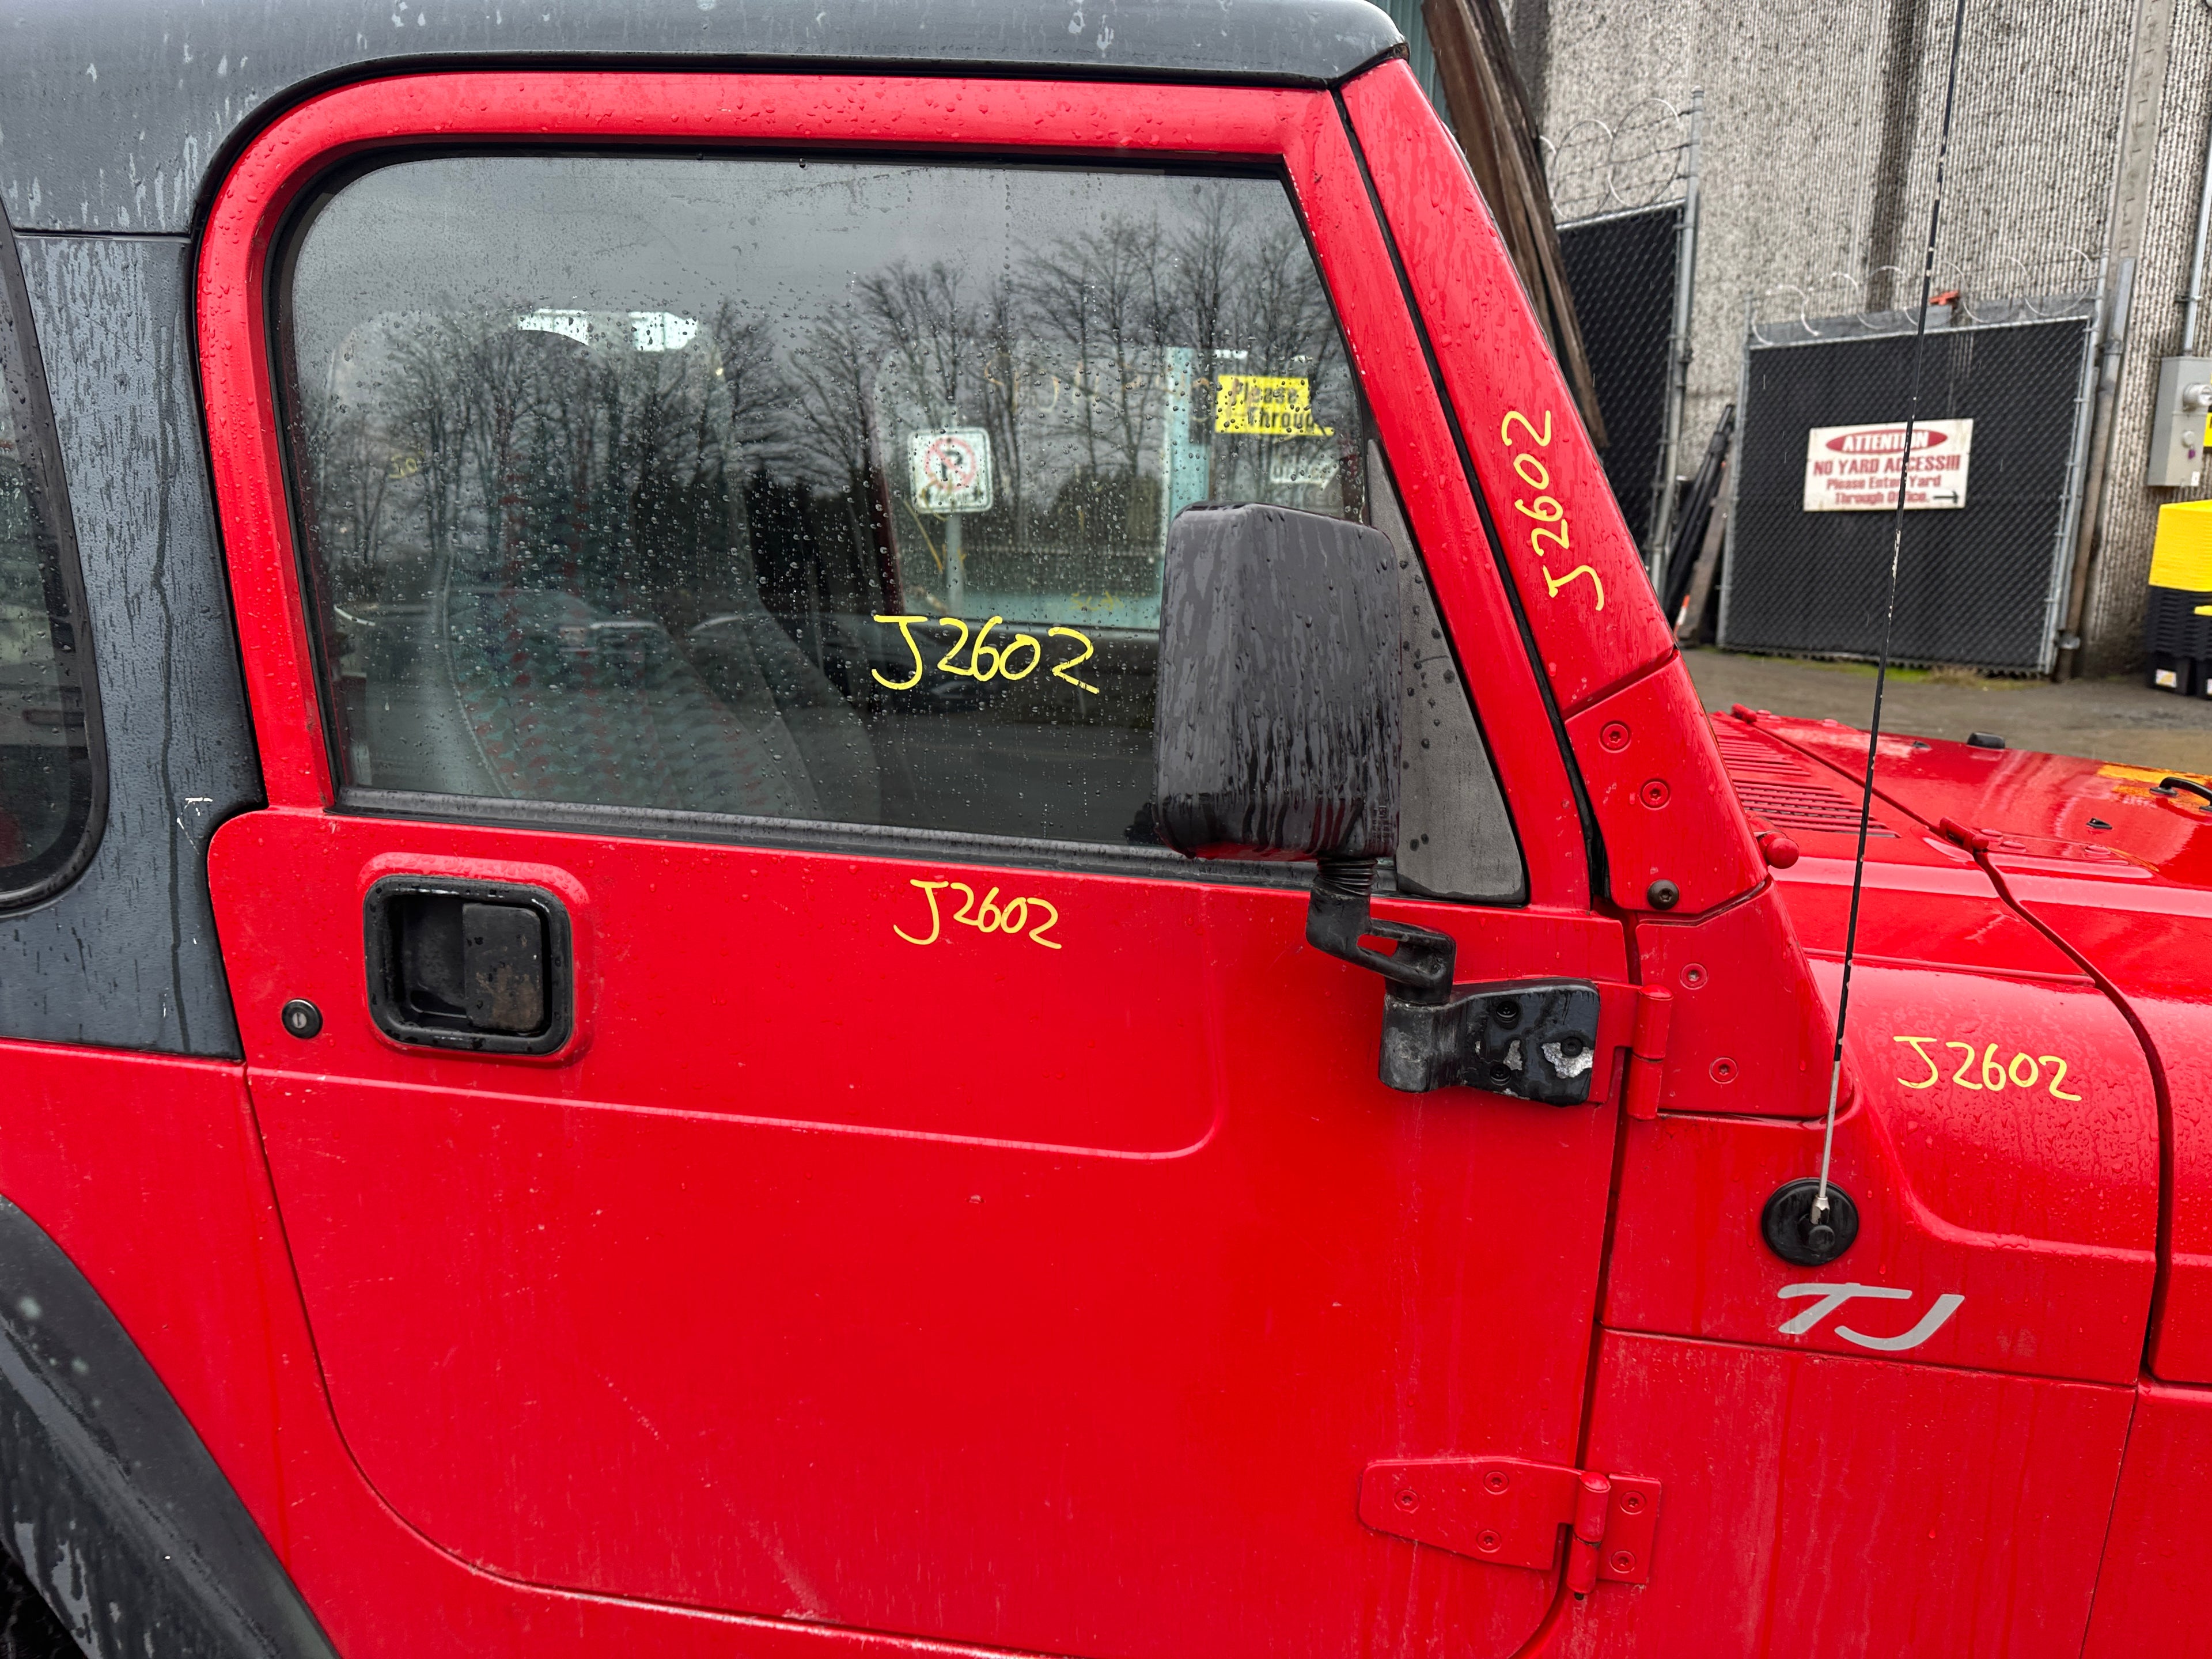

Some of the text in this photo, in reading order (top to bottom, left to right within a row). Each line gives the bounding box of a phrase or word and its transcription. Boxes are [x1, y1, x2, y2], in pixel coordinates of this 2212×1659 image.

[1813, 460, 1833, 475] NO
[1839, 458, 1880, 475] YARD
[1827, 479, 1865, 490] Please
[1909, 474, 1941, 487] Yard
[1835, 491, 1884, 505] Through
[1501, 410, 1604, 611] J2602
[872, 615, 1099, 694] J2602
[893, 879, 1062, 949] J2602
[1893, 1036, 2082, 1101] J2602
[1778, 1283, 1965, 1351] TJ
